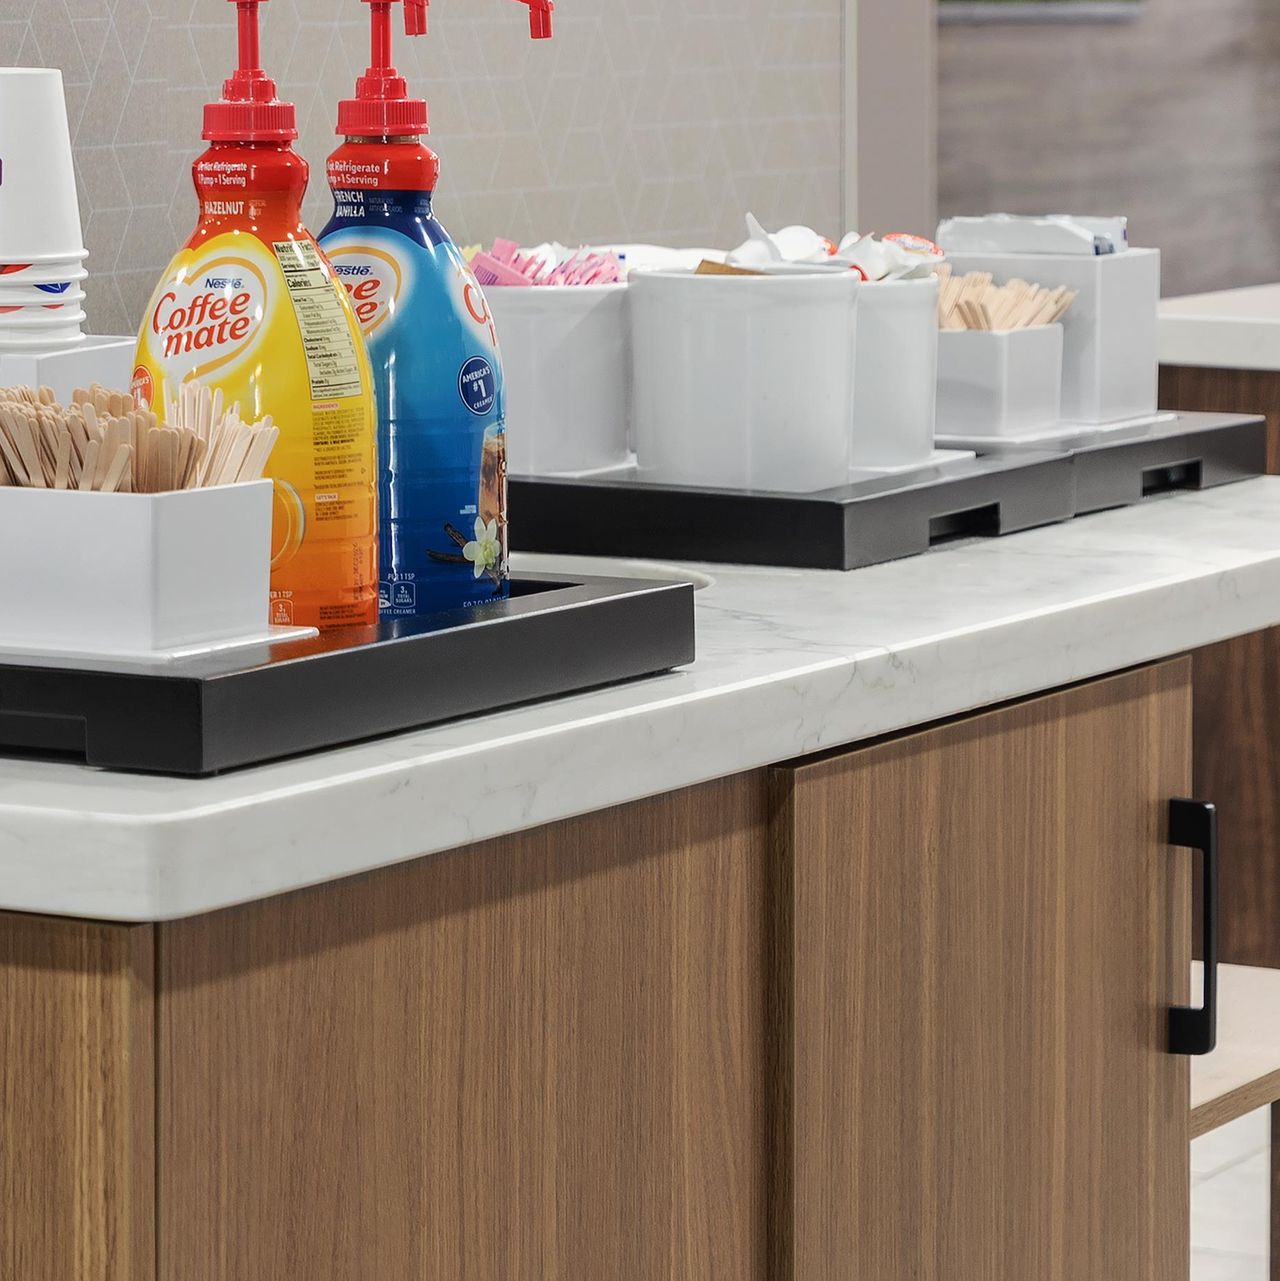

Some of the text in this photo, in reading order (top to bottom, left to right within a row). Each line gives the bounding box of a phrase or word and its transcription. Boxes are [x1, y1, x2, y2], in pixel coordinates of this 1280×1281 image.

[222, 174, 246, 188] Serving
[346, 173, 378, 187] Serving
[204, 201, 245, 215] HAZELNUT
[153, 292, 251, 335] Coffee
[164, 316, 251, 358] mate
